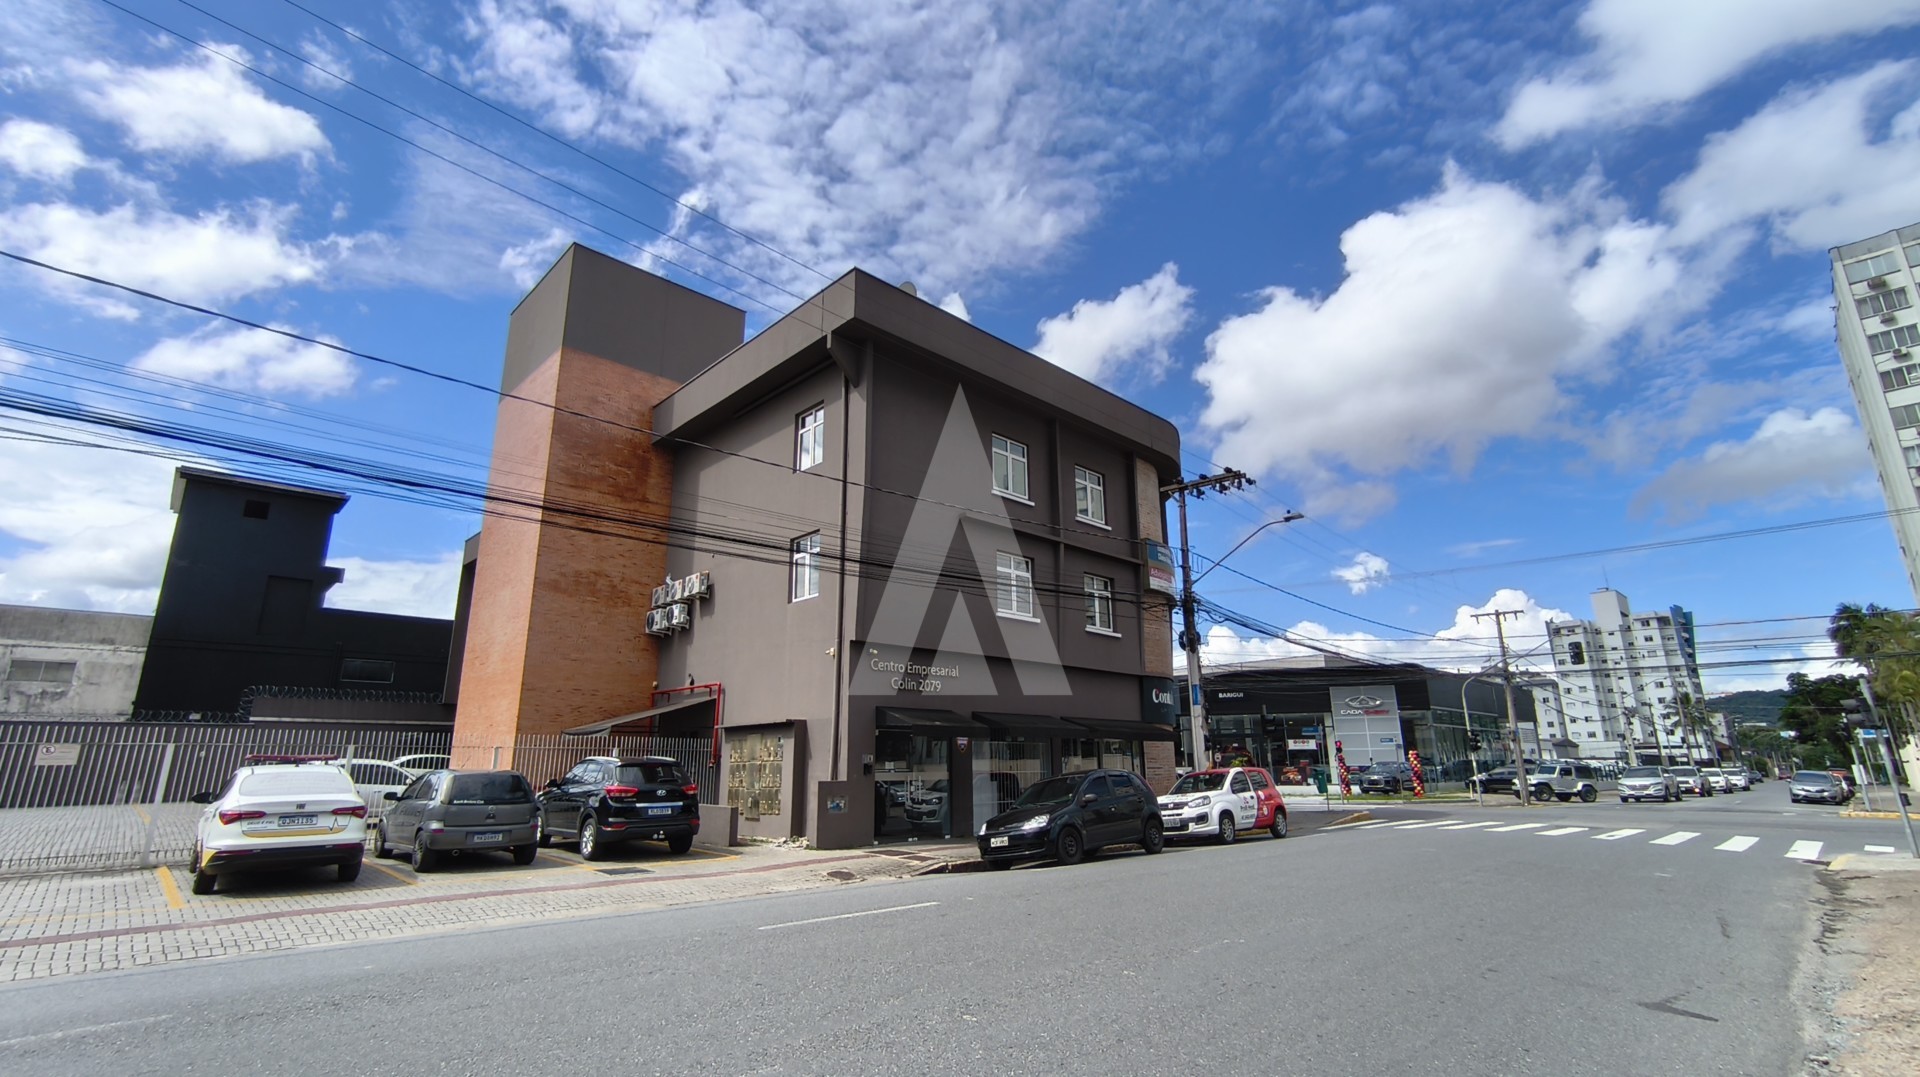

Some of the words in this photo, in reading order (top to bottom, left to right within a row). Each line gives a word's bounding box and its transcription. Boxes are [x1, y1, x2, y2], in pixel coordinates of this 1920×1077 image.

[870, 658, 905, 673] Centro
[907, 661, 960, 677] Empresarial
[891, 677, 917, 690] Colin
[918, 679, 942, 692] 2079
